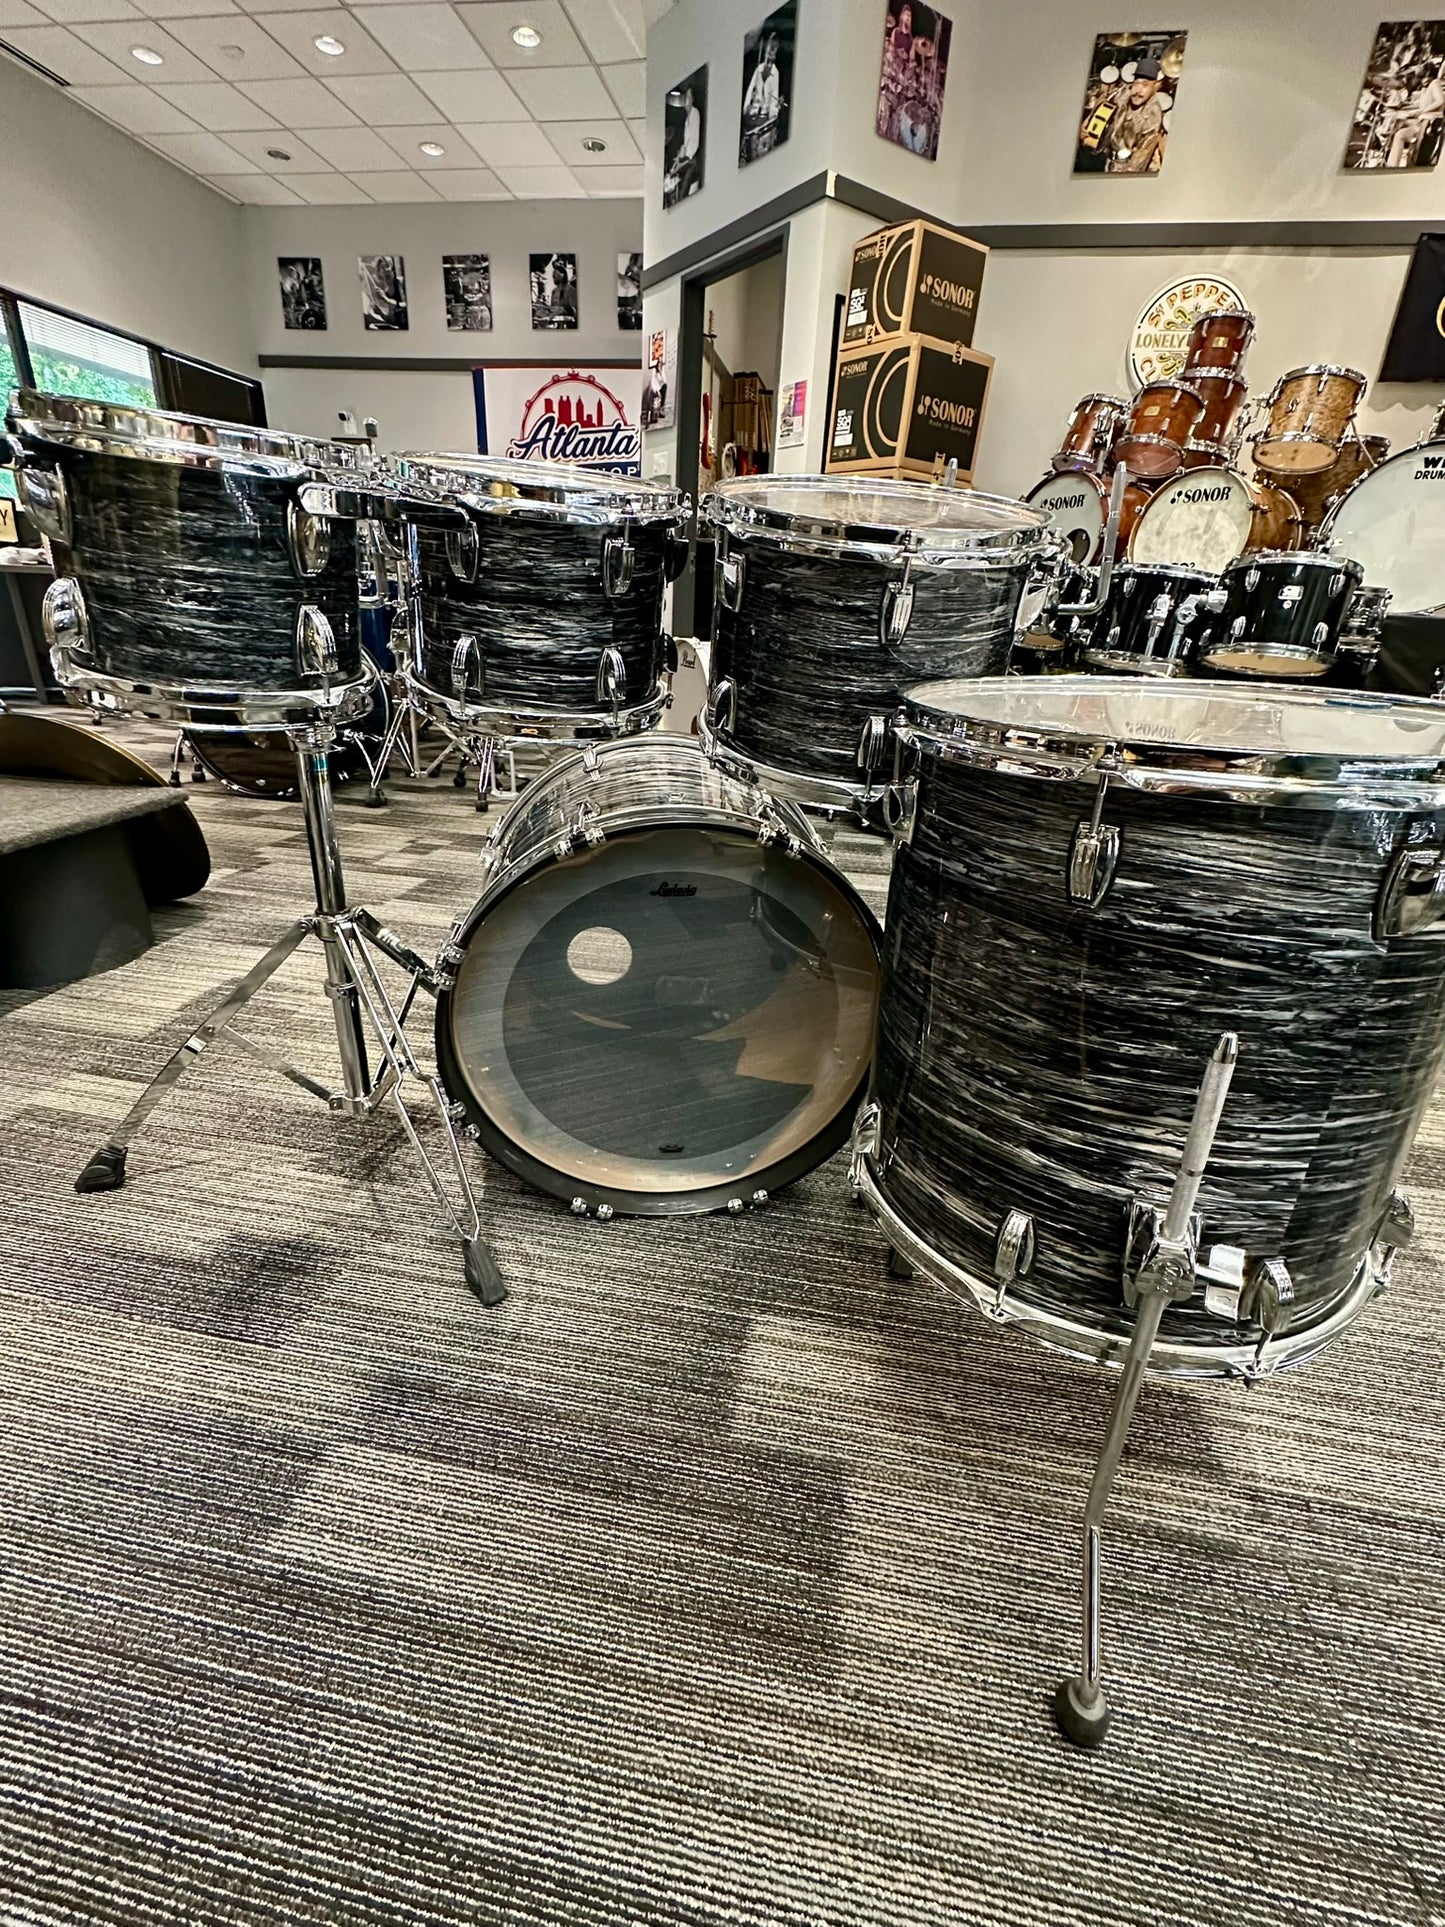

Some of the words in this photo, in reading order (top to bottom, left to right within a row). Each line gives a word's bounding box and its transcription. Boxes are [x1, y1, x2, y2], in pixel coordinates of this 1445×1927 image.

[932, 277, 975, 309] SONOR
[1135, 333, 1188, 349] LONELY
[931, 398, 974, 427] SONOR
[508, 413, 640, 461] Atlanta
[1048, 494, 1086, 511] SONOR
[1181, 487, 1232, 504] SONOR
